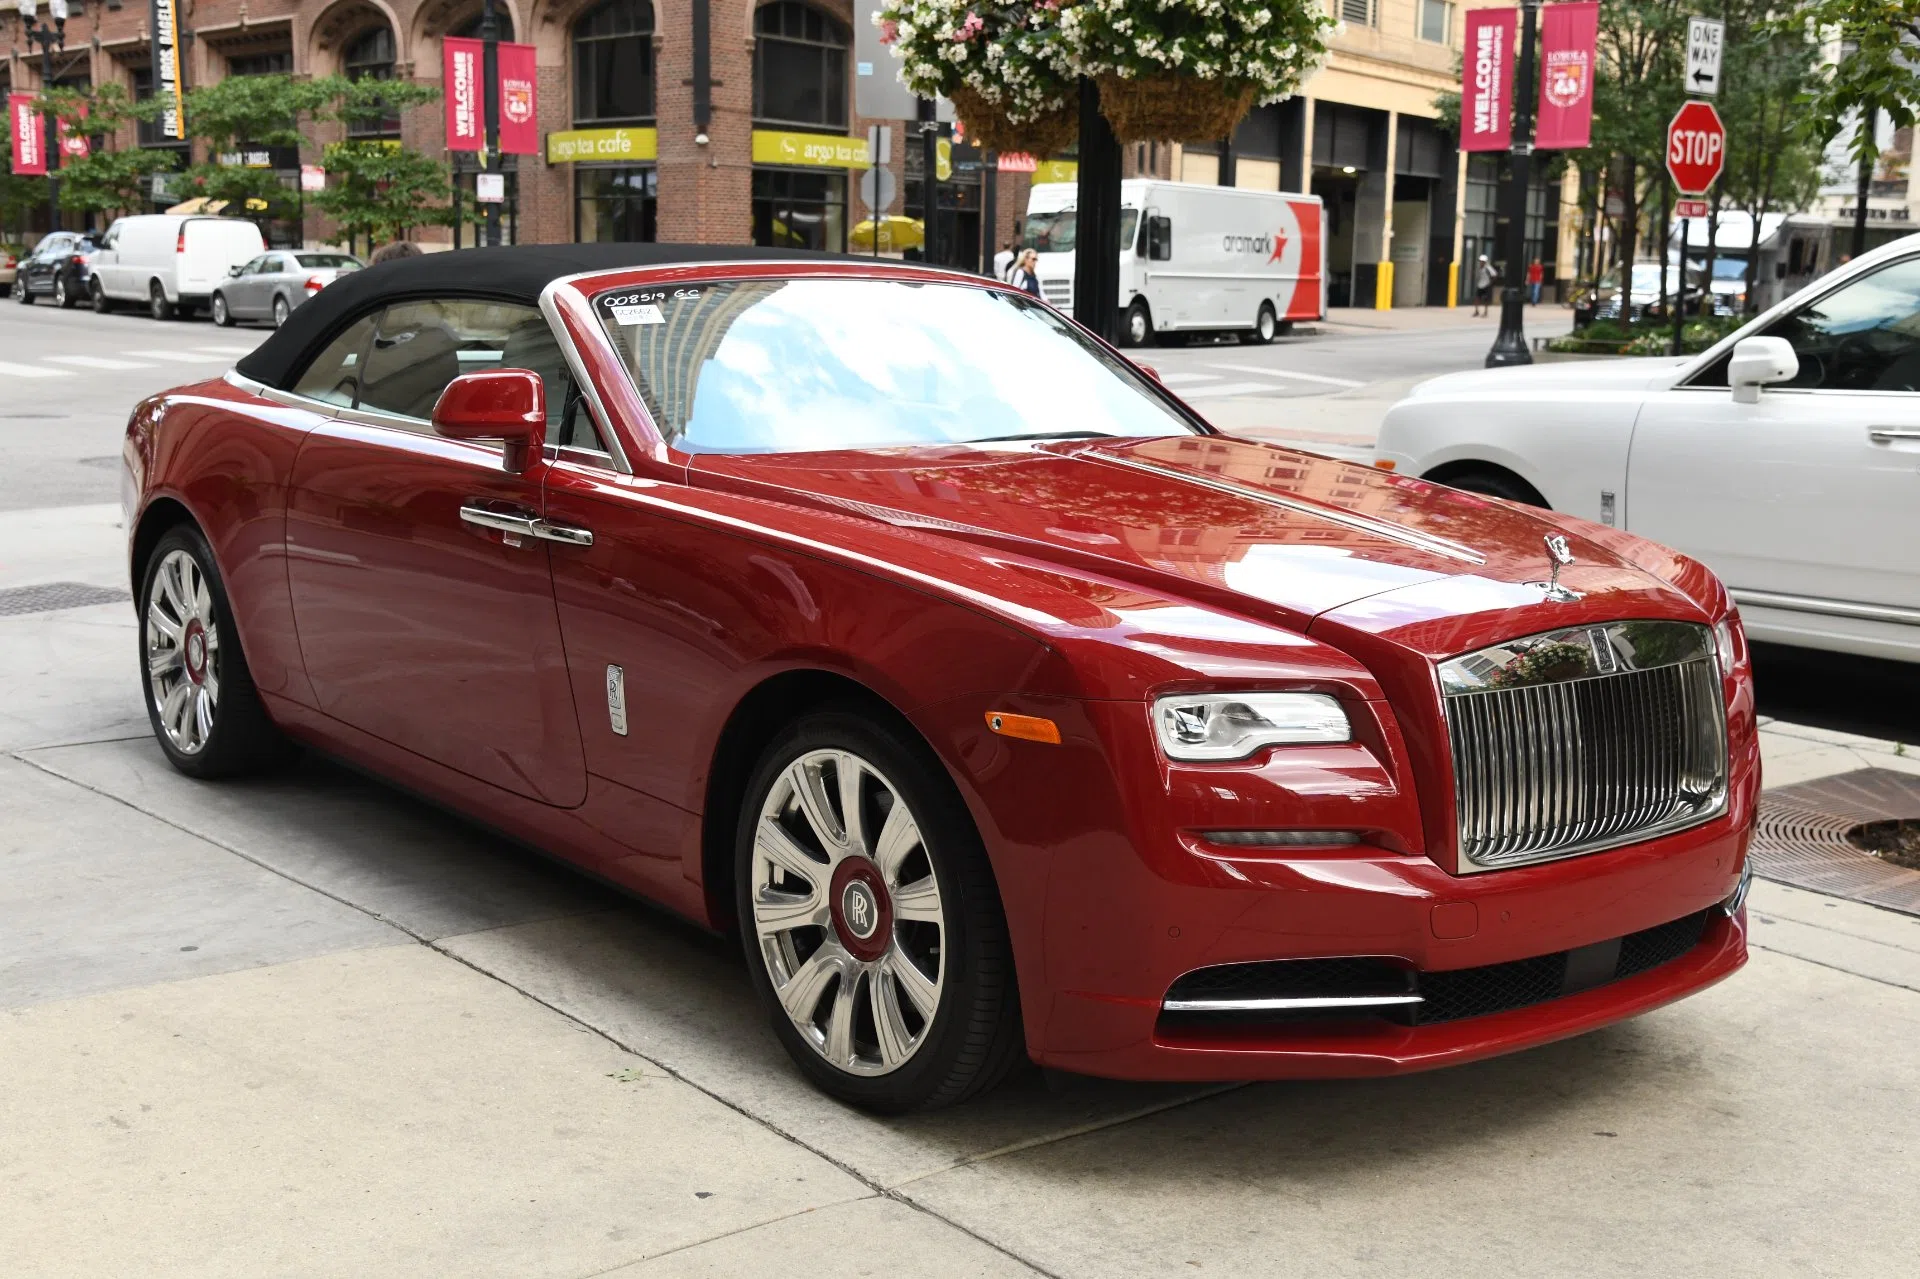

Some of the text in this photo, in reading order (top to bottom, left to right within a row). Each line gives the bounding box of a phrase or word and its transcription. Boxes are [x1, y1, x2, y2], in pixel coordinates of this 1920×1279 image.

[1693, 26, 1719, 45] ONE
[1691, 46, 1718, 62] WAY
[454, 51, 468, 137] WELCOME
[1474, 25, 1494, 134] WELCOME
[1489, 25, 1504, 134] WATER TOWER CAMPUS
[804, 144, 834, 165] argo
[1671, 129, 1722, 166] STOP
[1222, 231, 1272, 254] aramark
[604, 292, 666, 307] 008519
[852, 890, 869, 928] RR
